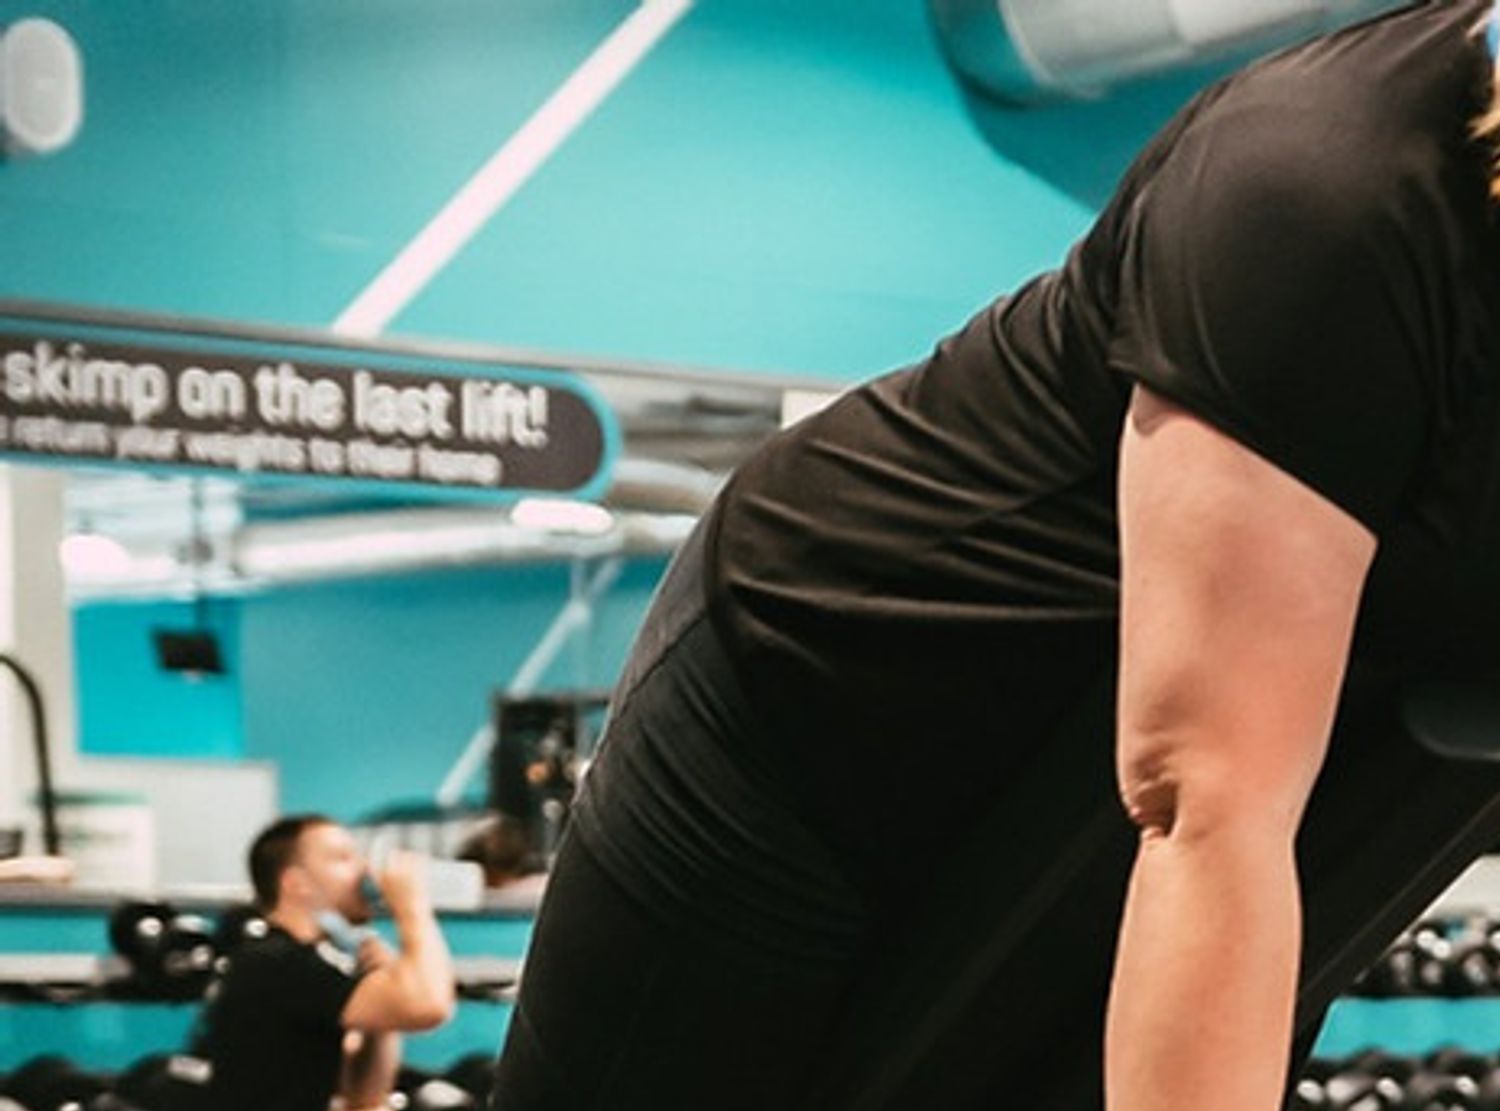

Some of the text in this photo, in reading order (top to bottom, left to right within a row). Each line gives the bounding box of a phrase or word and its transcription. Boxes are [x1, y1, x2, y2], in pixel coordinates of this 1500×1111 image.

[4, 341, 547, 447] skimp on the last lift!
